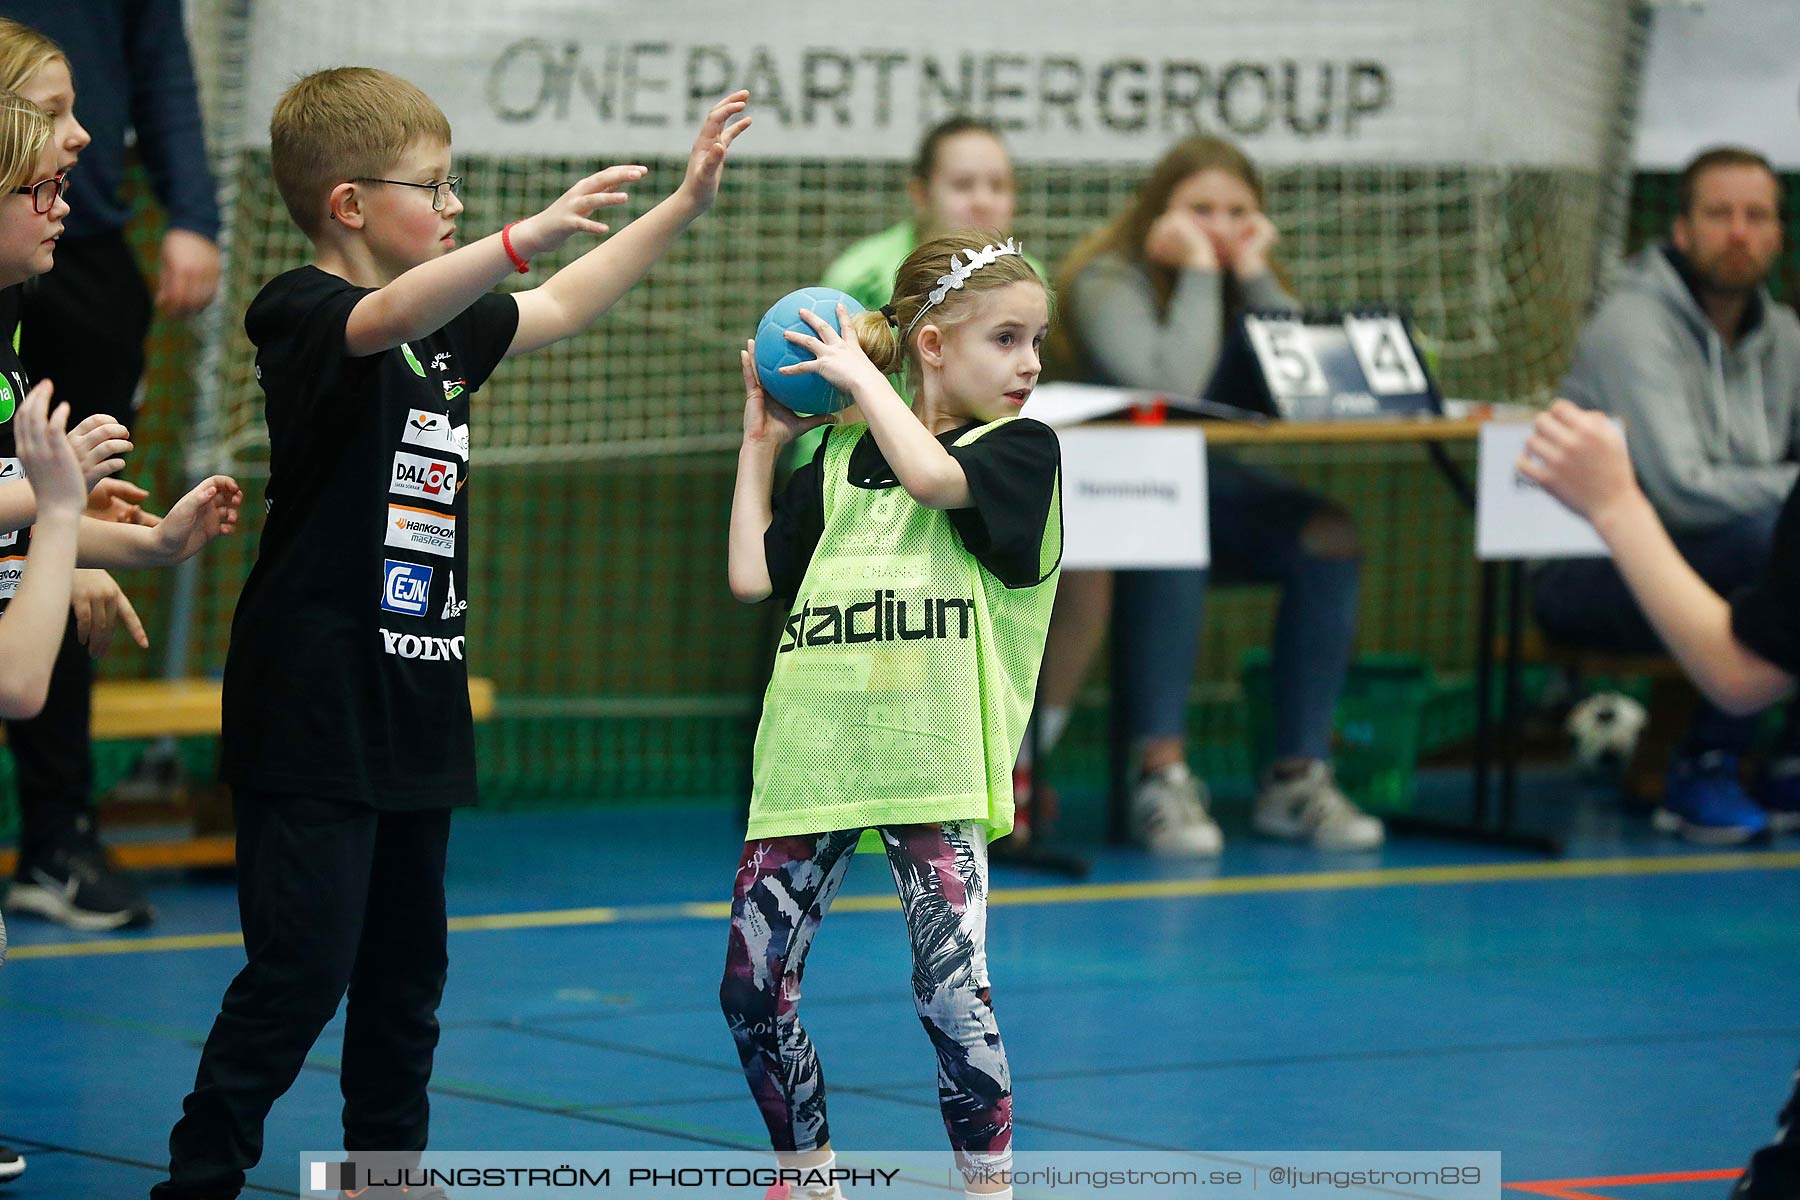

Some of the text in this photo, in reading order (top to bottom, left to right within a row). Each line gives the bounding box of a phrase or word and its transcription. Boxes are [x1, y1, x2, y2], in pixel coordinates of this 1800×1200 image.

[486, 37, 1392, 136] ONEPARTNERGROUP
[1267, 326, 1412, 387] 5 4
[396, 463, 454, 491] DALOC
[386, 566, 427, 611] CEJN
[780, 589, 974, 654] stadium
